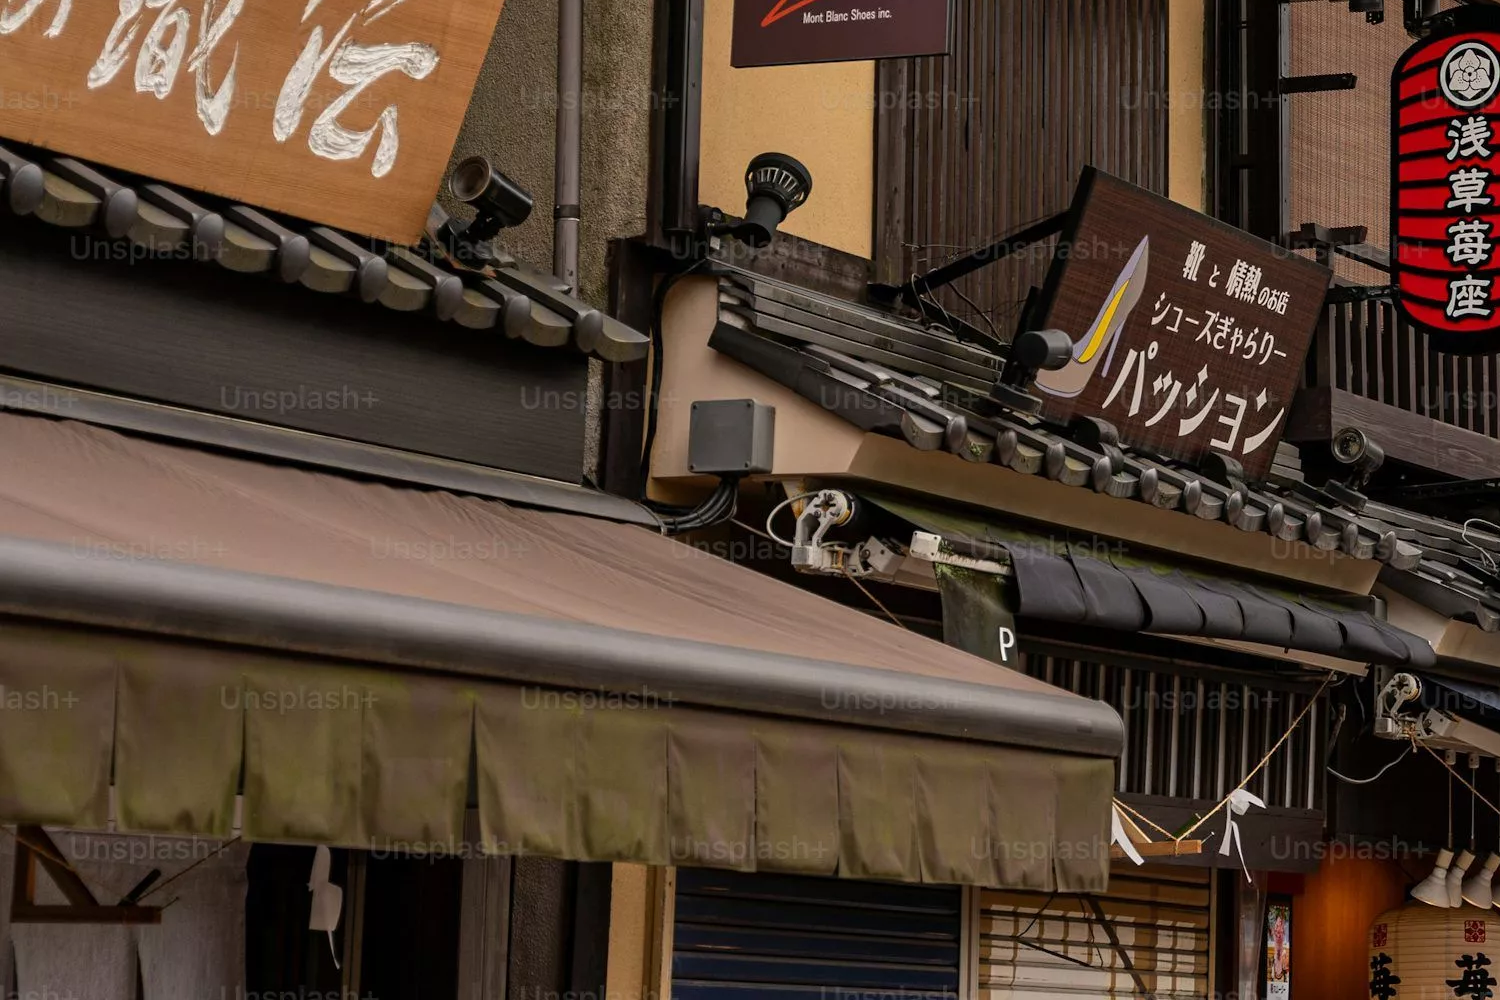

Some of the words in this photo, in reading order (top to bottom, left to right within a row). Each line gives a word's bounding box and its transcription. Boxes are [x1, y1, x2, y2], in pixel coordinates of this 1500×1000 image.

[803, 10, 823, 24] Mont
[826, 8, 848, 22] Blanc
[851, 7, 875, 21] Shoes
[1445, 116, 1493, 321] 浅草苺座
[1102, 341, 1285, 454] パッション
